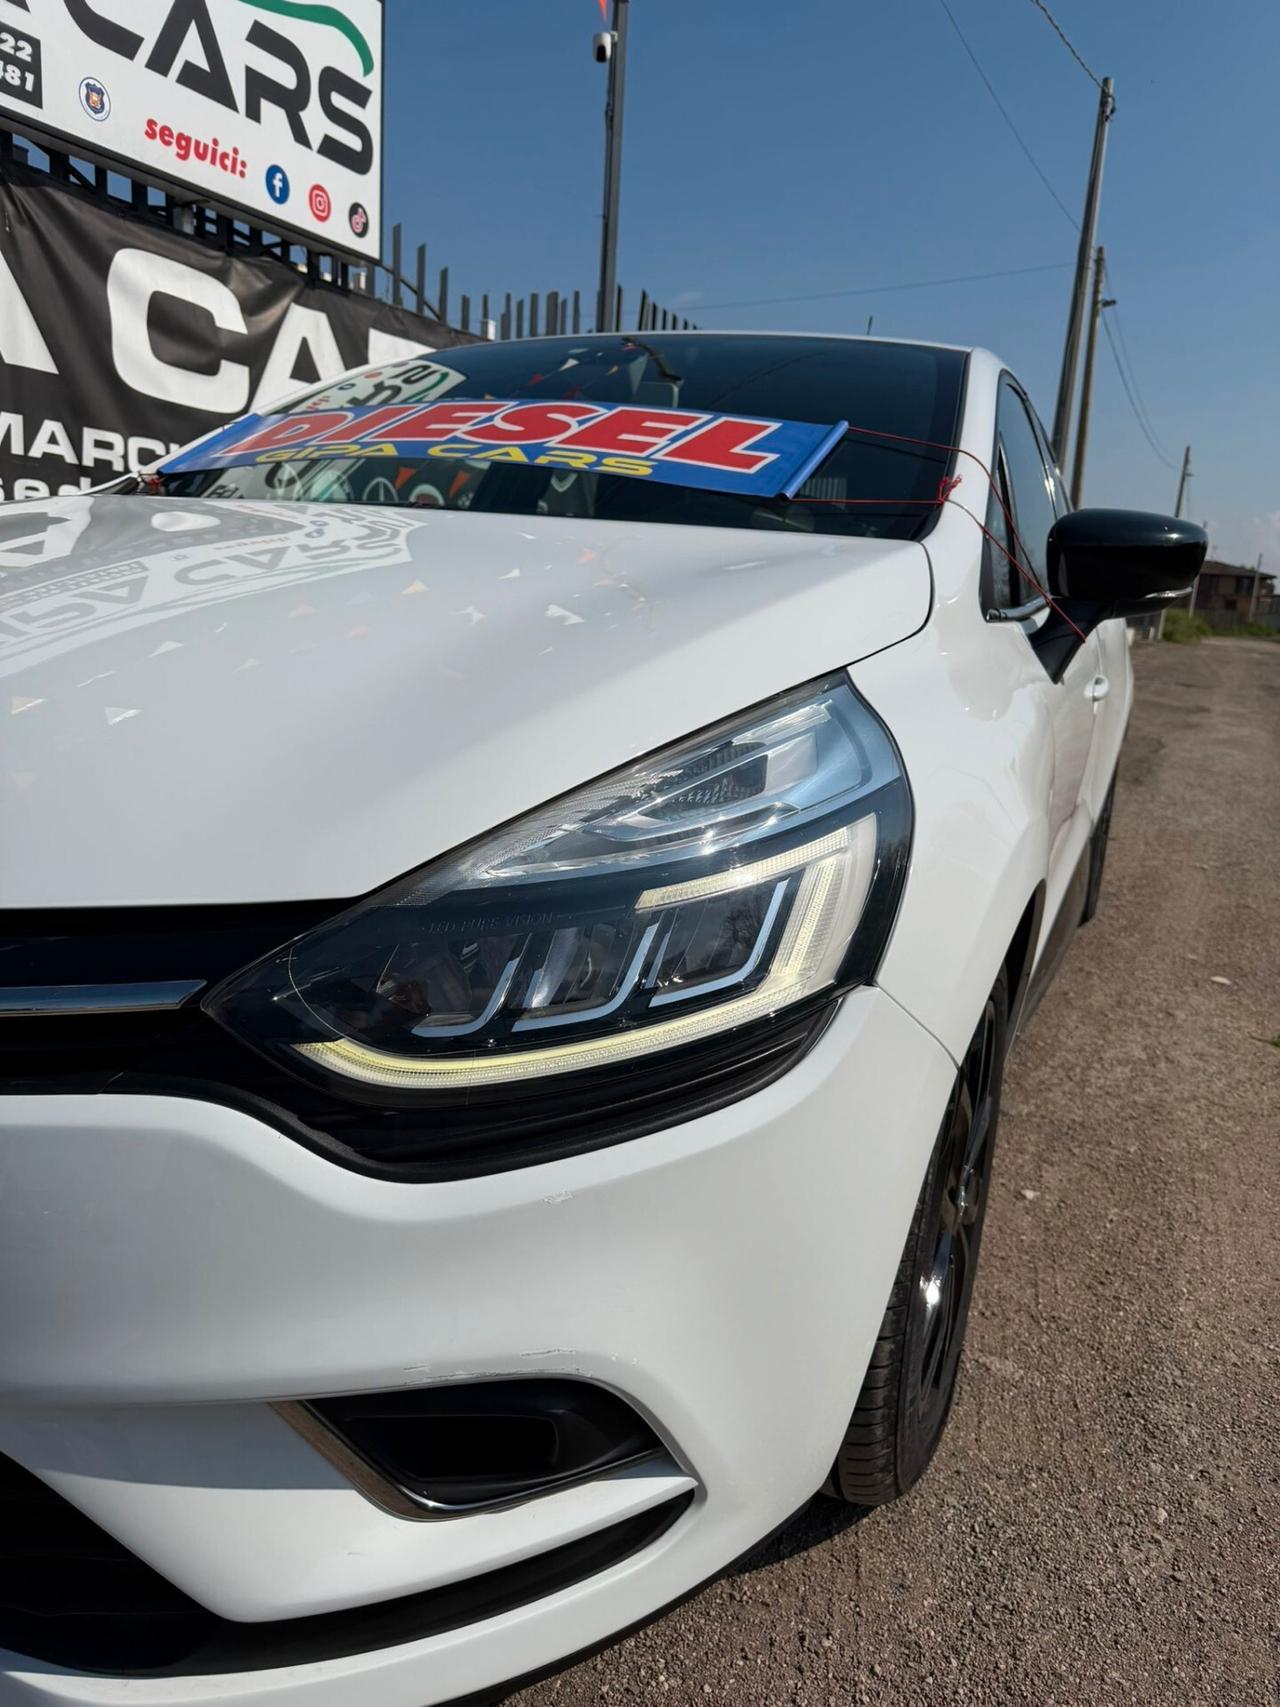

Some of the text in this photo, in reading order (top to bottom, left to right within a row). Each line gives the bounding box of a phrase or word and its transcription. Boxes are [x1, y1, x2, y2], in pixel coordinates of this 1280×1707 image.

[144, 118, 247, 179] seguici:
[107, 248, 437, 413] CA
[0, 411, 181, 475] ARC
[210, 402, 782, 474] DIESEL
[256, 443, 658, 476] GIPA CARS
